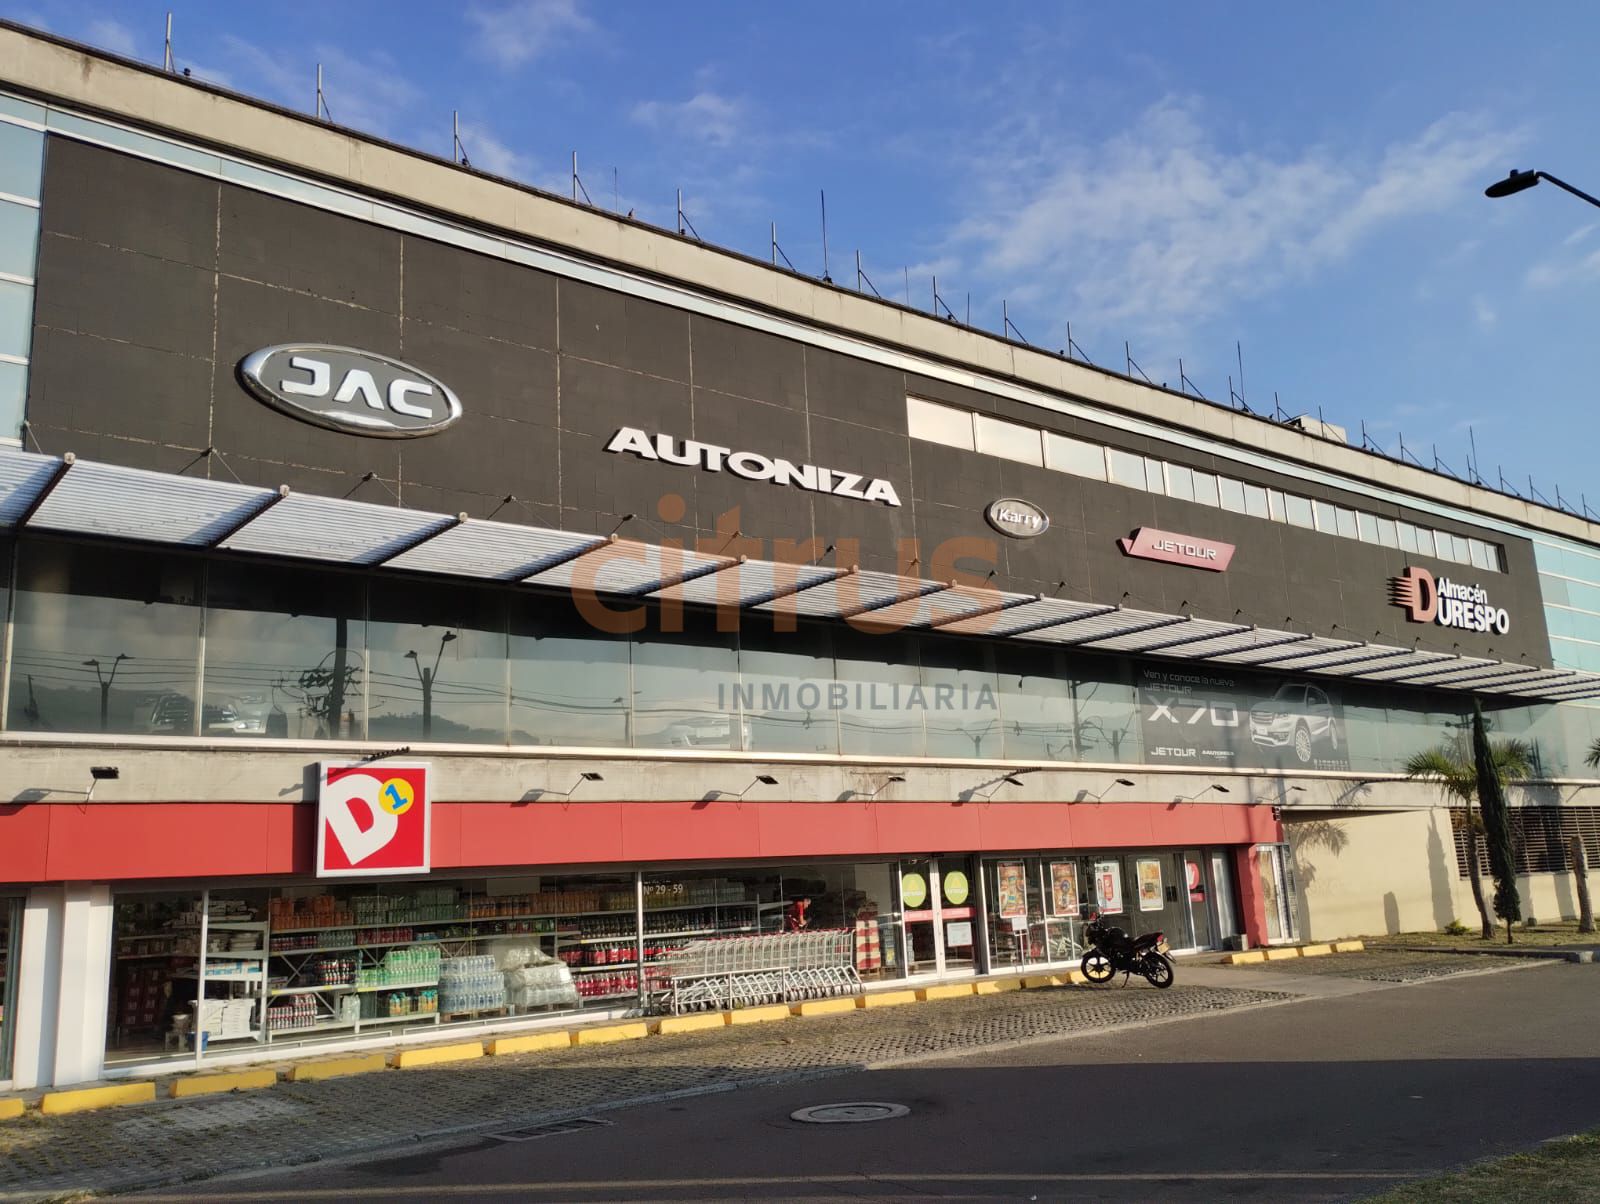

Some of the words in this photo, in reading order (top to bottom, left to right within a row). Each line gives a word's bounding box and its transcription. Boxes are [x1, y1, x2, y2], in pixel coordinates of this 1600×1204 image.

[281, 357, 433, 418] JAC
[607, 427, 902, 506] AUTONIZA
[999, 508, 1041, 529] Karry
[1152, 540, 1217, 560] JETOUR
[1438, 577, 1488, 604] Almacén
[1144, 682, 1192, 695] JETOUR
[1146, 694, 1239, 727] X70
[1151, 746, 1197, 757] JETOUR
[655, 884, 666, 895] 29
[673, 883, 684, 894] 59
